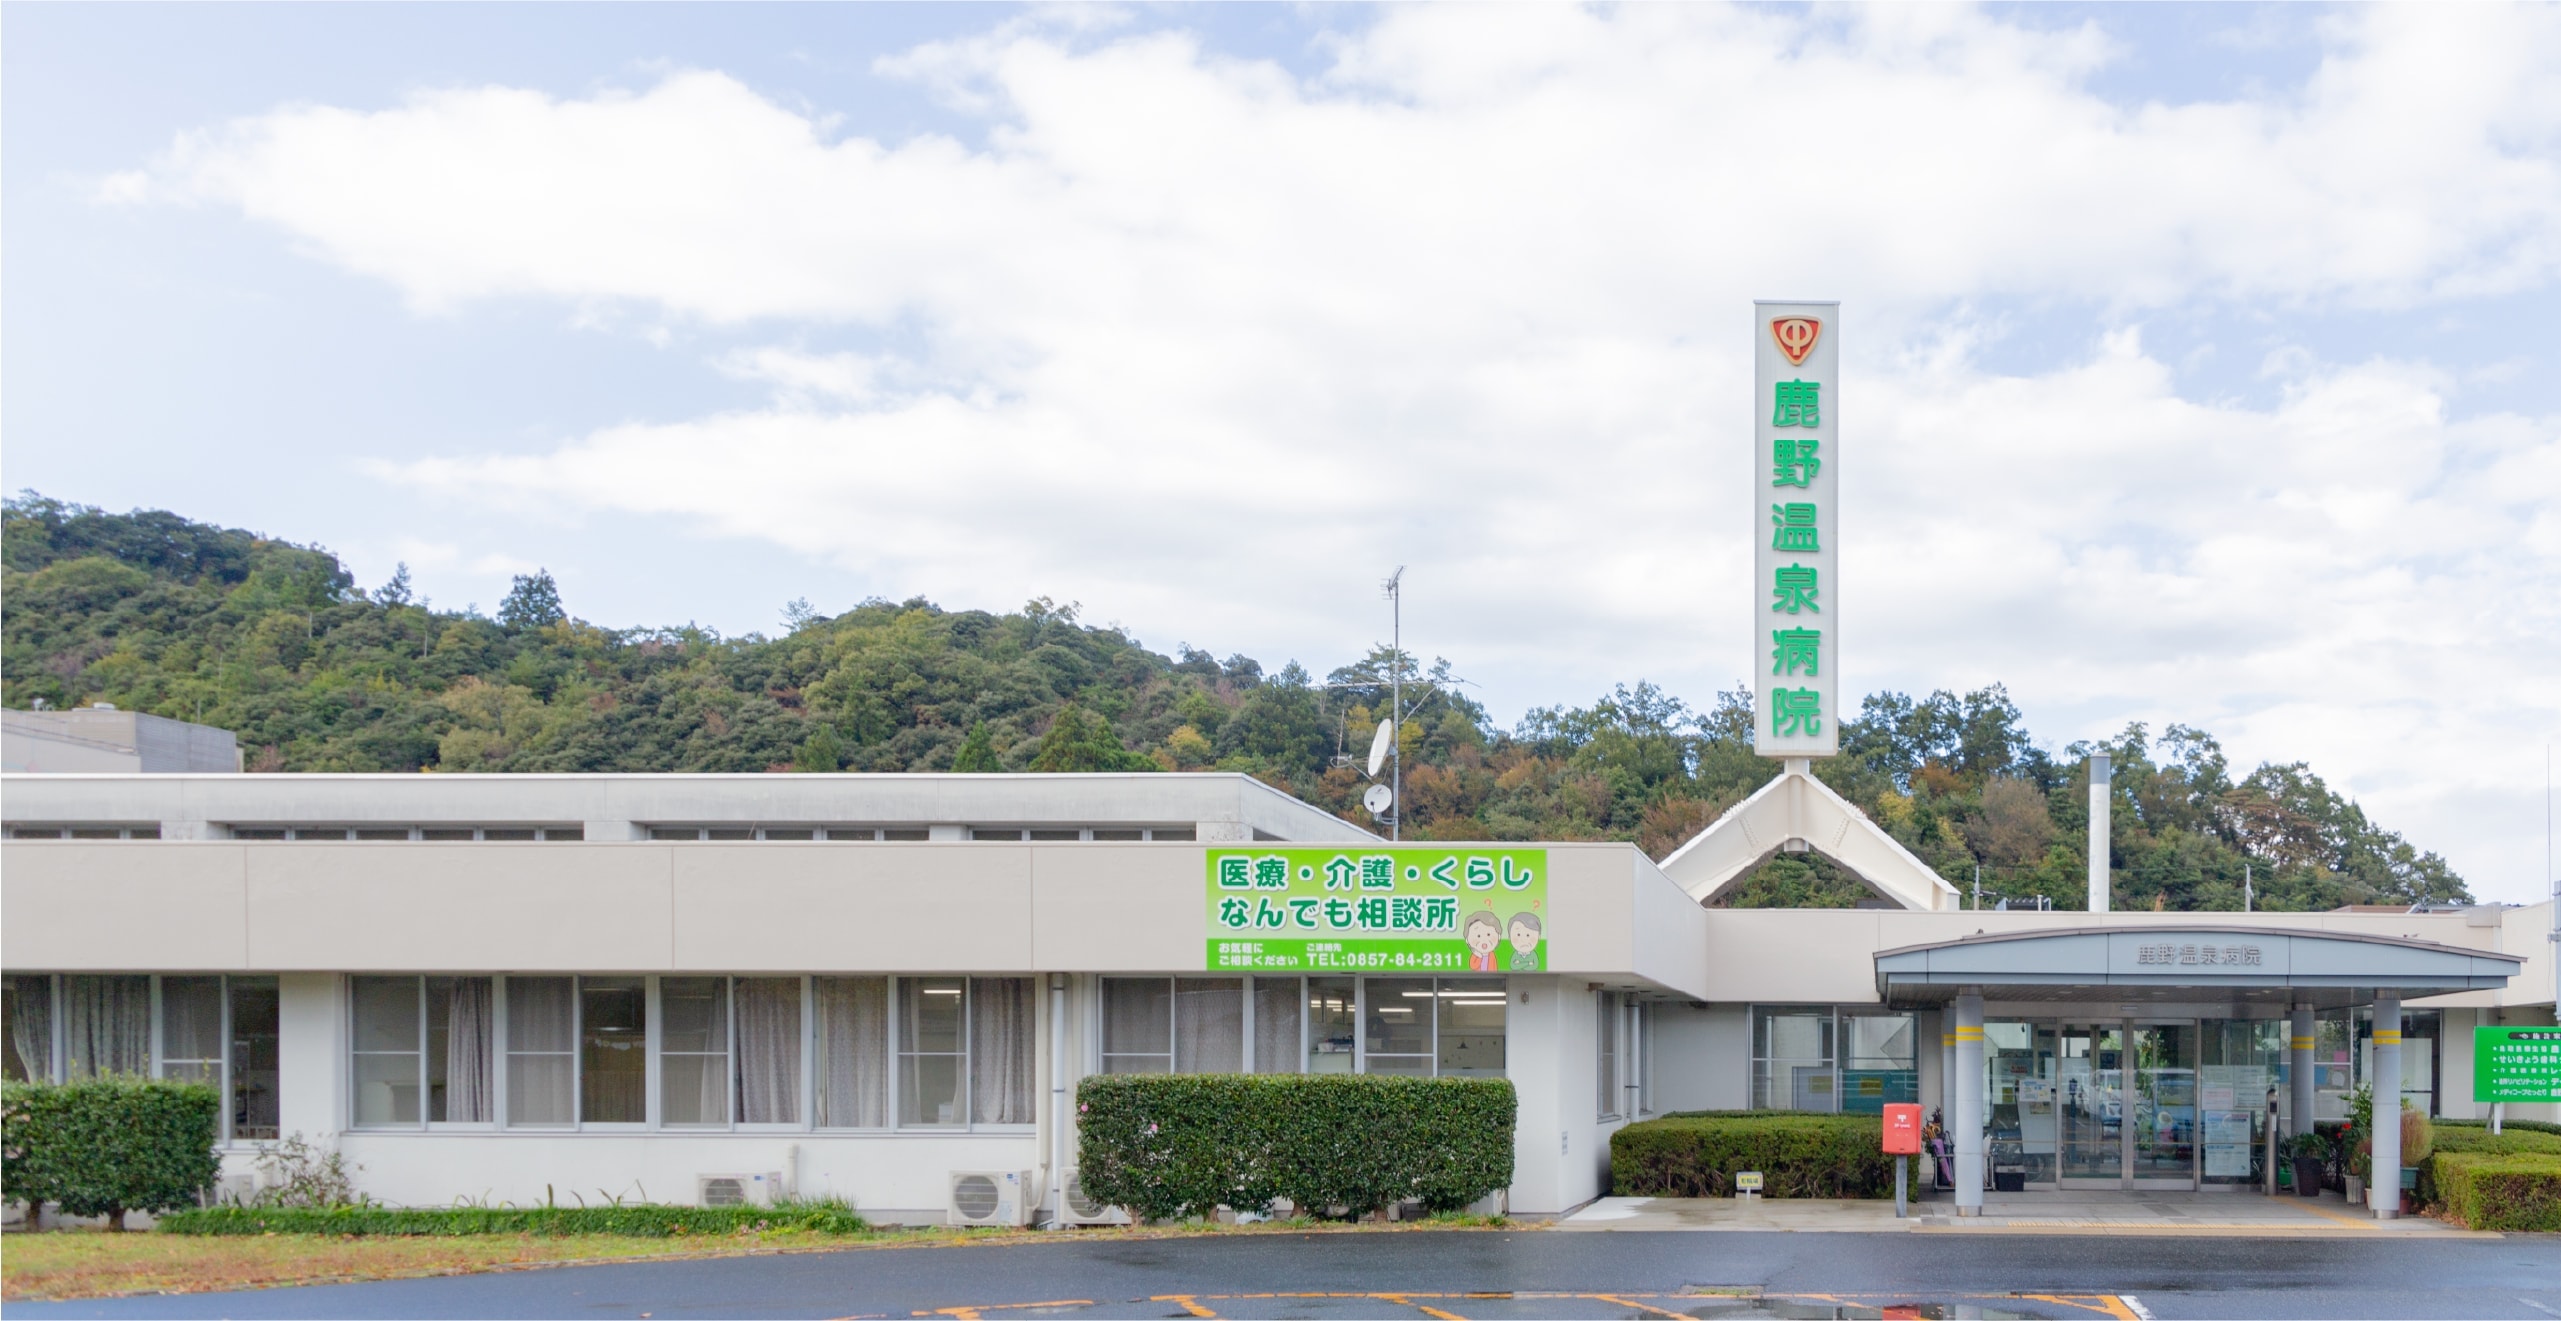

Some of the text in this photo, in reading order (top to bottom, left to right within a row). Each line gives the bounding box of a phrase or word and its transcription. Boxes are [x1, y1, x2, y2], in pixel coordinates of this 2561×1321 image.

[1771, 377, 1822, 738] 鹿野温泉病院
[1220, 858, 1530, 888] 医療・介護・くらし
[1220, 897, 1457, 928] なんでも相談所
[1218, 942, 1263, 954] お気軽に
[2137, 943, 2262, 966] 鹿野温泉病院
[1218, 955, 1298, 966] ご相談ください
[1306, 953, 1462, 967] TEL:0857-84-2311
[2499, 1055, 2561, 1064] せいきょう歯科
